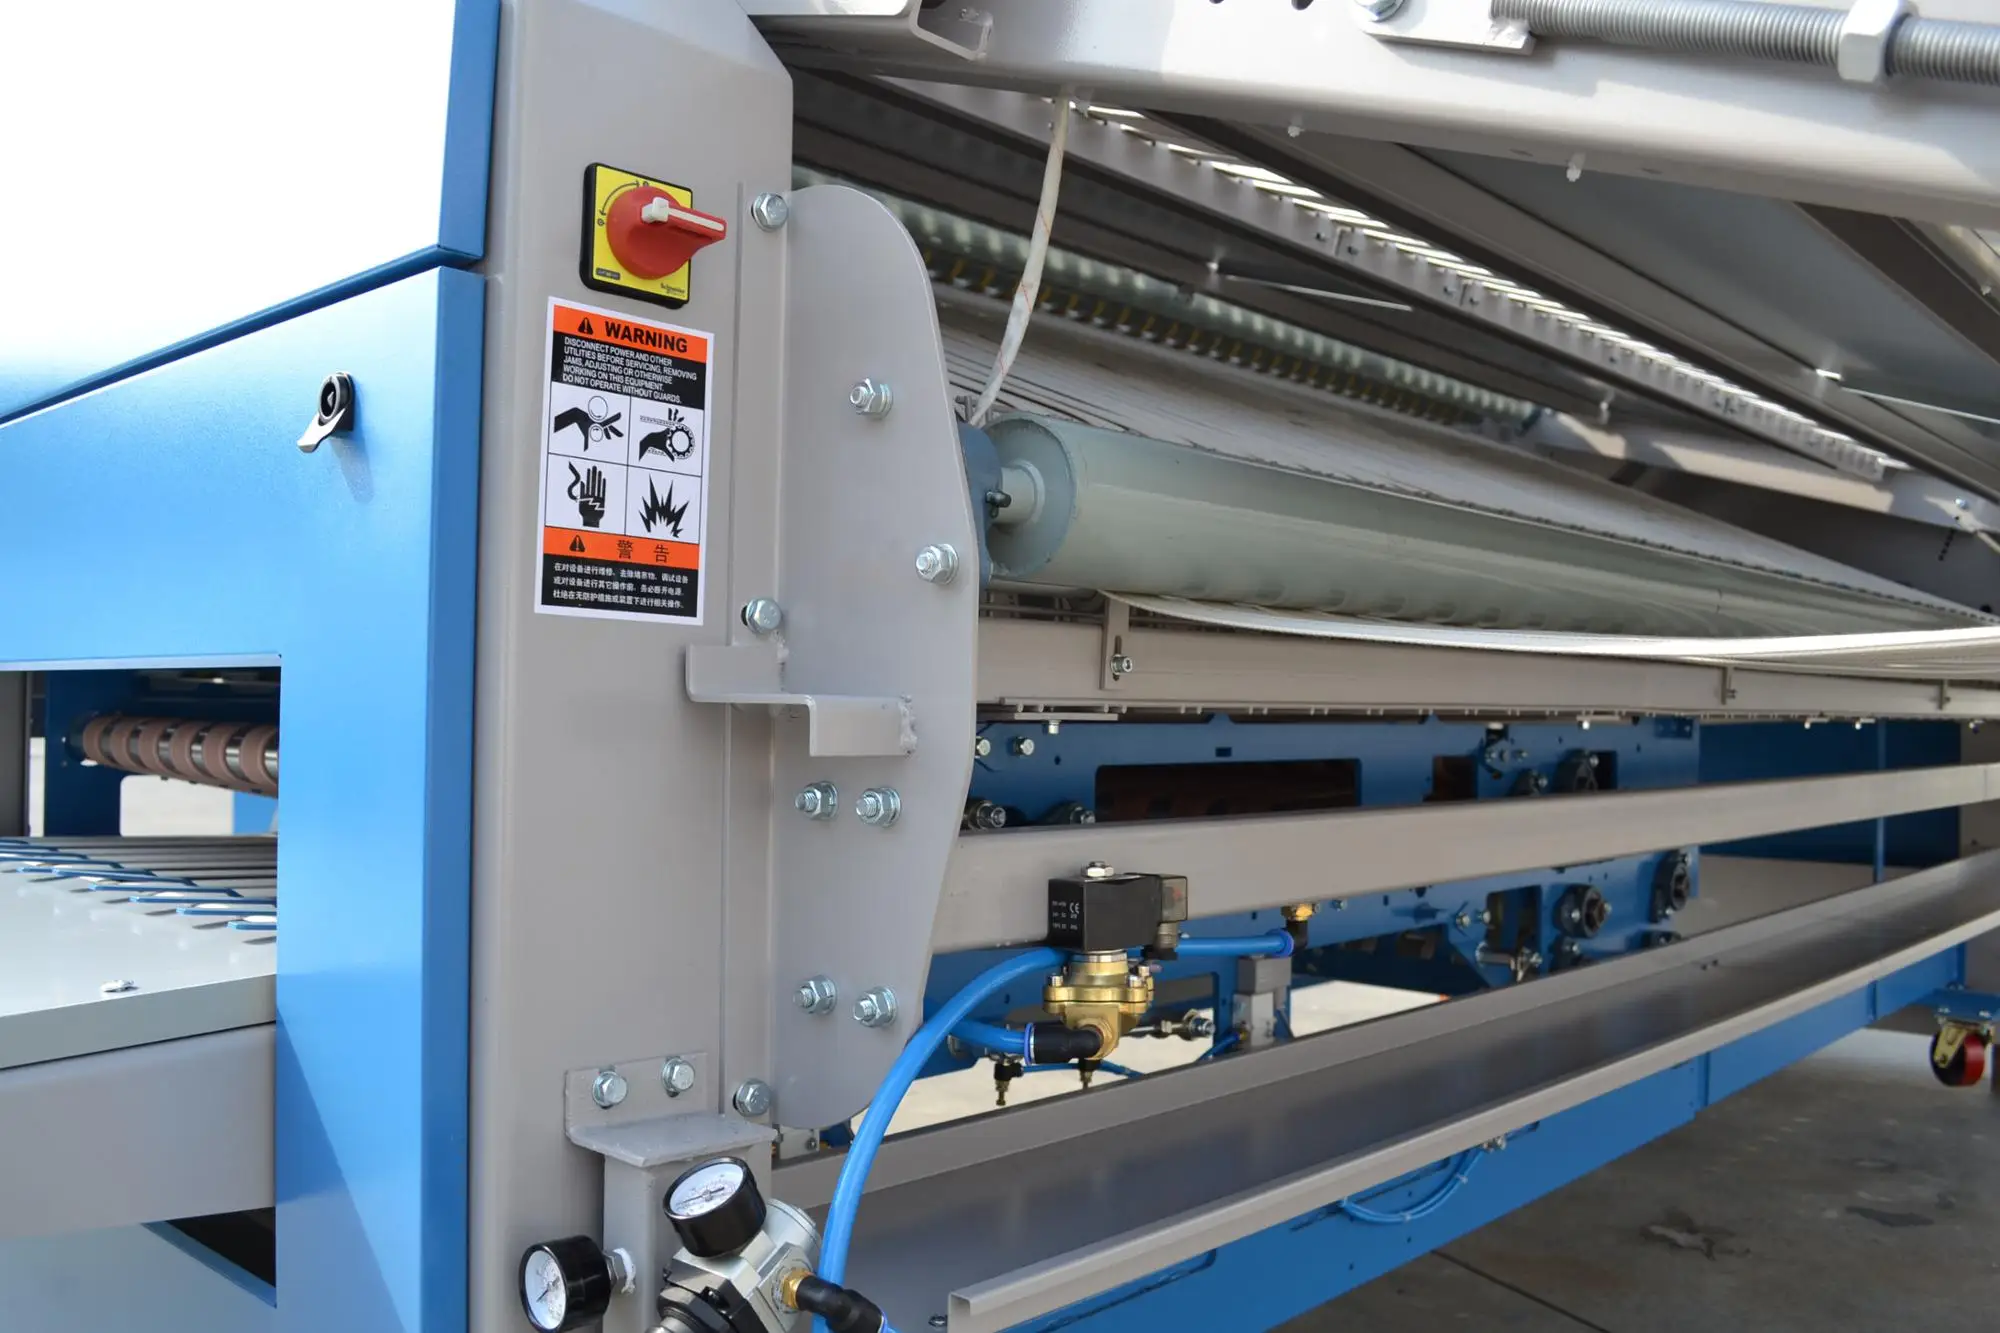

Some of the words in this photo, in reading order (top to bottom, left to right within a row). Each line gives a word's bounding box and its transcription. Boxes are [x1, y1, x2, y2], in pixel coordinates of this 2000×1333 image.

[564, 336, 609, 353] DISCONNECT
[610, 346, 635, 359] POWER
[635, 351, 649, 362] AND
[650, 355, 672, 367] OTHER
[605, 321, 688, 353] WARNING
[563, 363, 597, 378] WORKING
[597, 371, 608, 380] ON
[609, 373, 624, 384] THIS
[624, 376, 664, 391] EQUIPMENT.
[564, 345, 596, 360] UTILITIES
[597, 352, 625, 366] BEFORE
[663, 366, 697, 381] REMOVING
[585, 359, 623, 374] ADJUSTING
[623, 367, 633, 377] OR
[634, 369, 672, 385] OTHERWISE
[562, 373, 573, 383] DO
[574, 375, 589, 386] NOT
[590, 378, 621, 392] OPERATE
[622, 385, 653, 398] WITHOUT
[653, 391, 682, 404] GUARDS.
[616, 540, 669, 563] 警告
